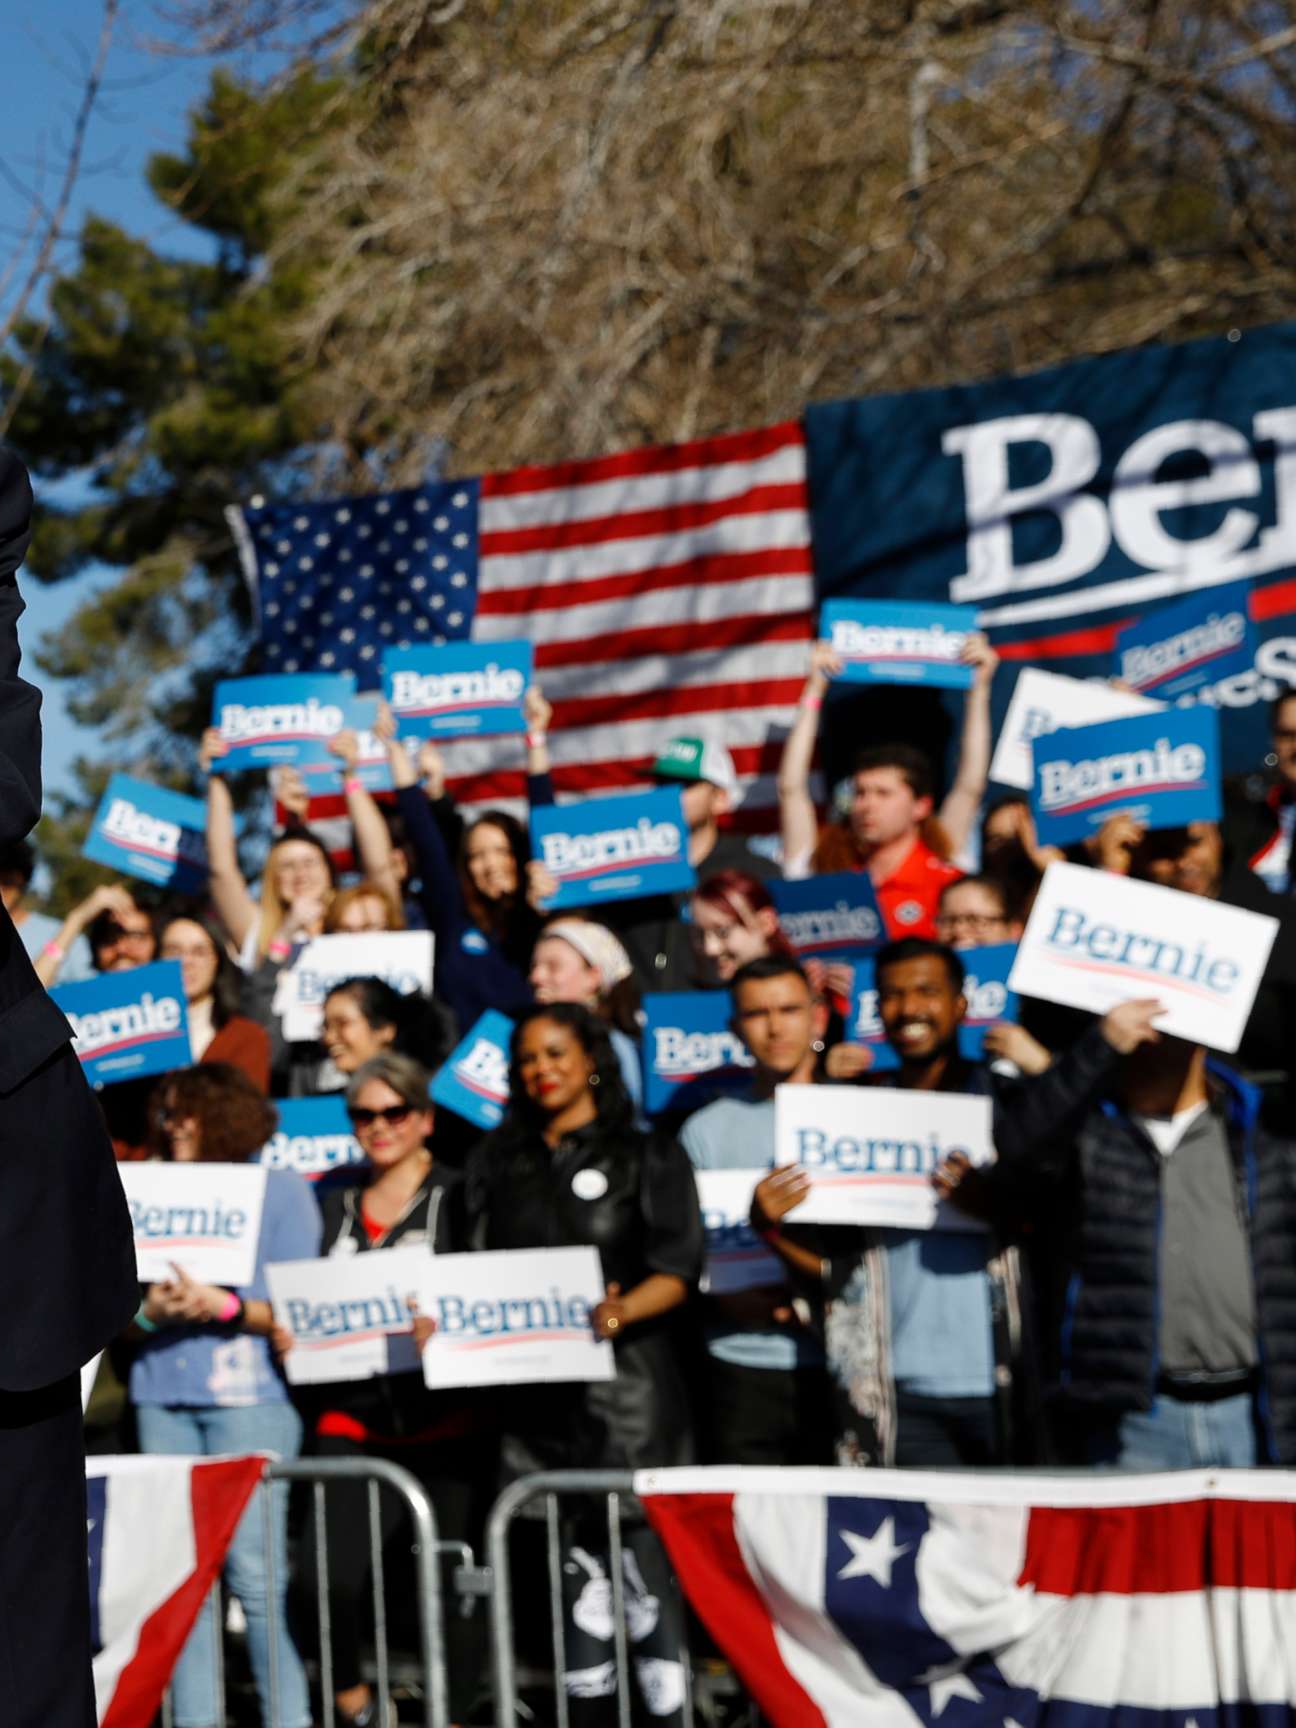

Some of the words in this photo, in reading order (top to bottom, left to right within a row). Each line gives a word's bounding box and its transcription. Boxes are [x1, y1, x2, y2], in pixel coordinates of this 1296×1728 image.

[831, 619, 967, 659] Bernie
[1120, 611, 1246, 685] Bernie
[392, 662, 525, 707] Bernie
[221, 697, 344, 738] Bernie
[1038, 737, 1206, 804] Bernie
[541, 817, 680, 871] Bernie
[779, 900, 880, 947] ernie
[1046, 904, 1241, 994] Bernie
[437, 1286, 593, 1333] Bernie
